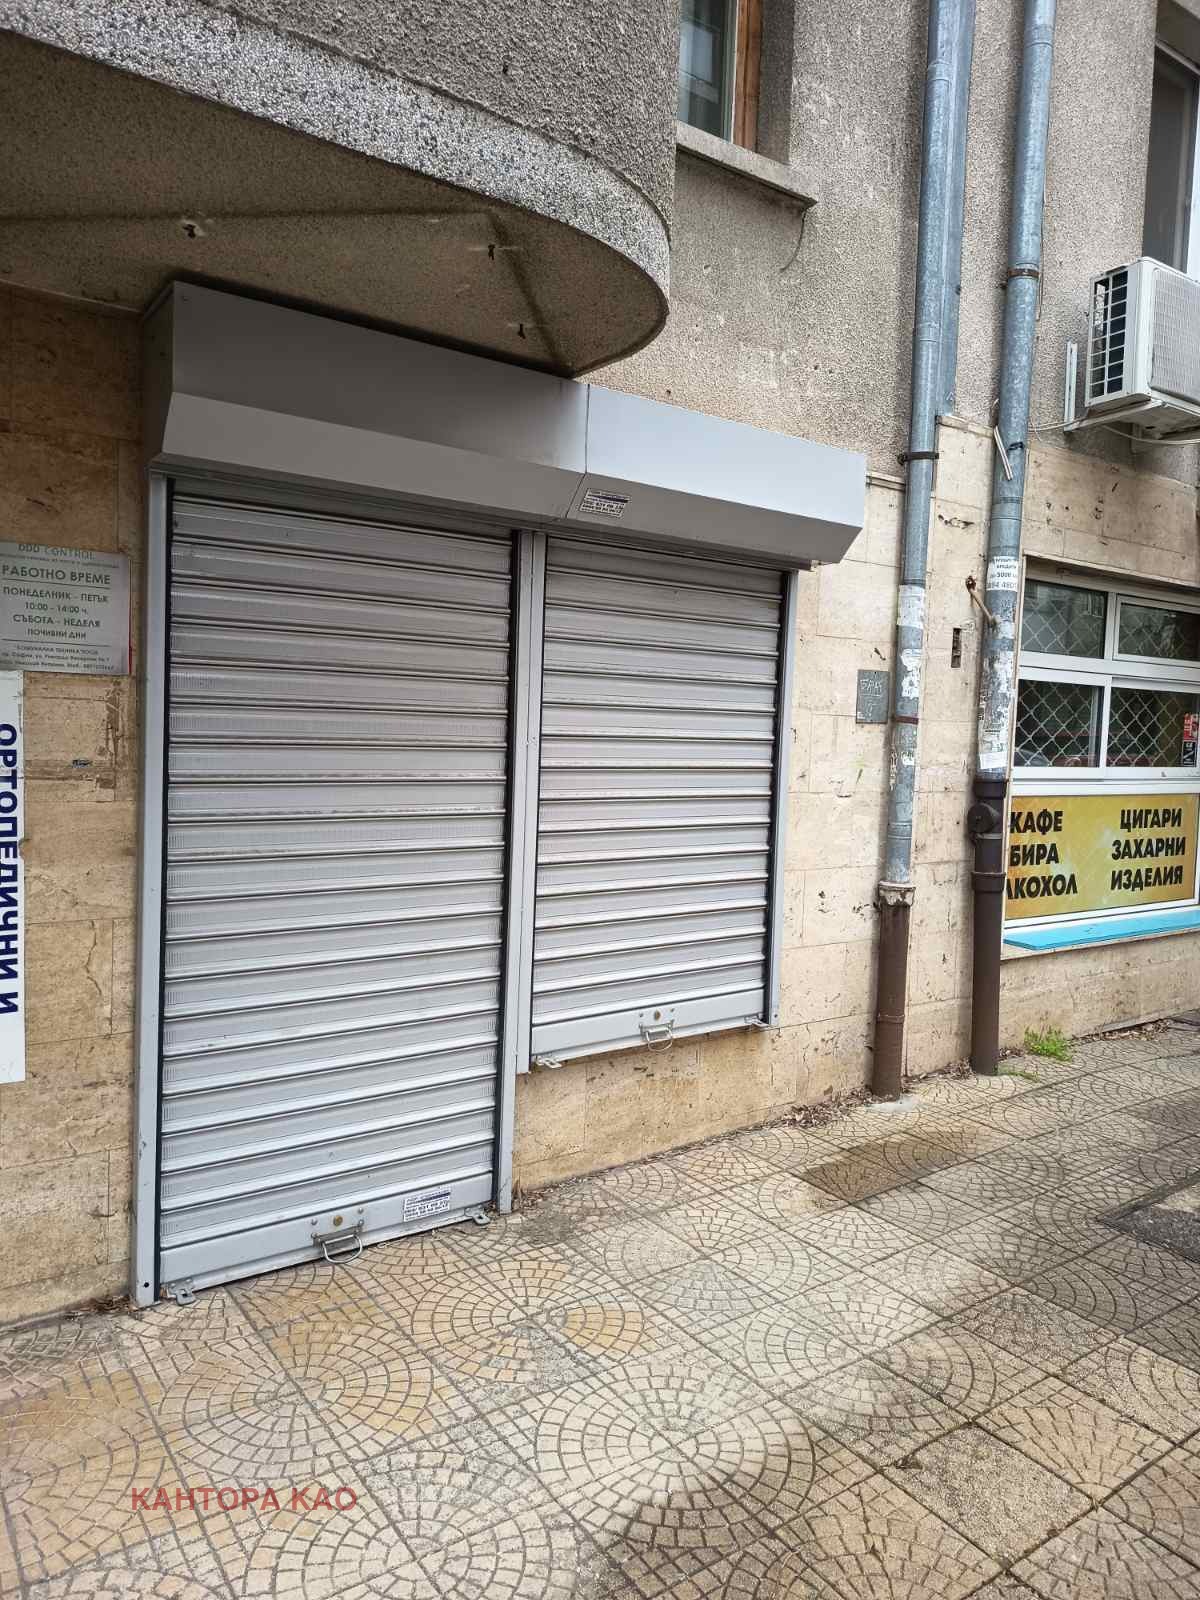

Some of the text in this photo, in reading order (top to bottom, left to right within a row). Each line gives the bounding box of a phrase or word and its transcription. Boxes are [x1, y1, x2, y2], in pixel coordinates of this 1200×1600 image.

[2, 565, 111, 585] РАБОТНО ВРЕМЕ
[3, 586, 71, 600] ПОНЕДЕЛНИК
[81, 592, 109, 603] ПЕТЪК
[13, 614, 54, 625] СЪБОТА
[63, 617, 101, 628] НЕДЕЛЯ
[27, 628, 86, 640] ПОЧИВНИ ДНИ
[1010, 809, 1064, 835] КАФЕ
[1120, 808, 1183, 832] ЦИГАРИ
[1010, 843, 1060, 867] БИРА
[1111, 837, 1187, 860] ЗАХАРНИ
[0, 723, 19, 1015] ОРТОПЕДИЧНИ И
[1110, 865, 1184, 891] ИЗДЕЛИЯ
